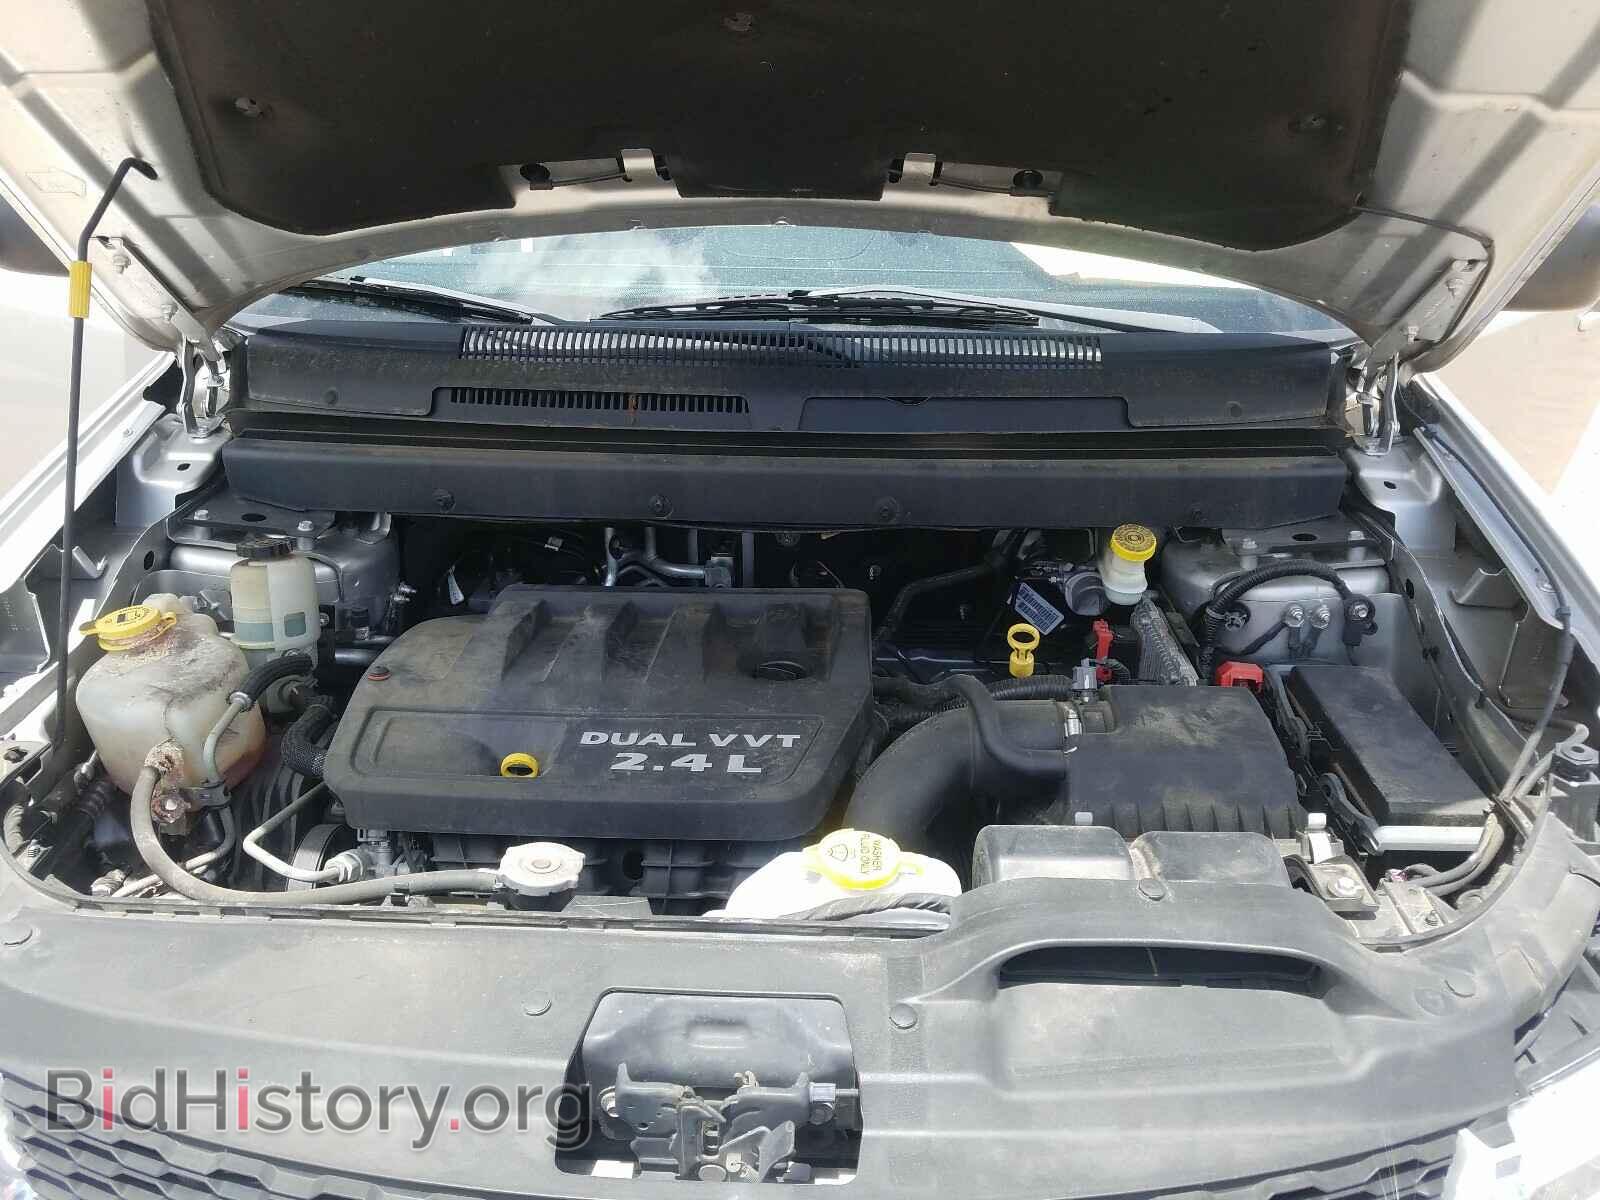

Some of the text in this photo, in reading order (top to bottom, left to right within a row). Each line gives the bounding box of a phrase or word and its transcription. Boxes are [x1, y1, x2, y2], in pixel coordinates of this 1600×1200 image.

[580, 731, 801, 748] DUAL VVT
[610, 752, 762, 773] 2.4 L
[860, 834, 872, 874] FLUID ONLY
[872, 840, 883, 871] WASHER
